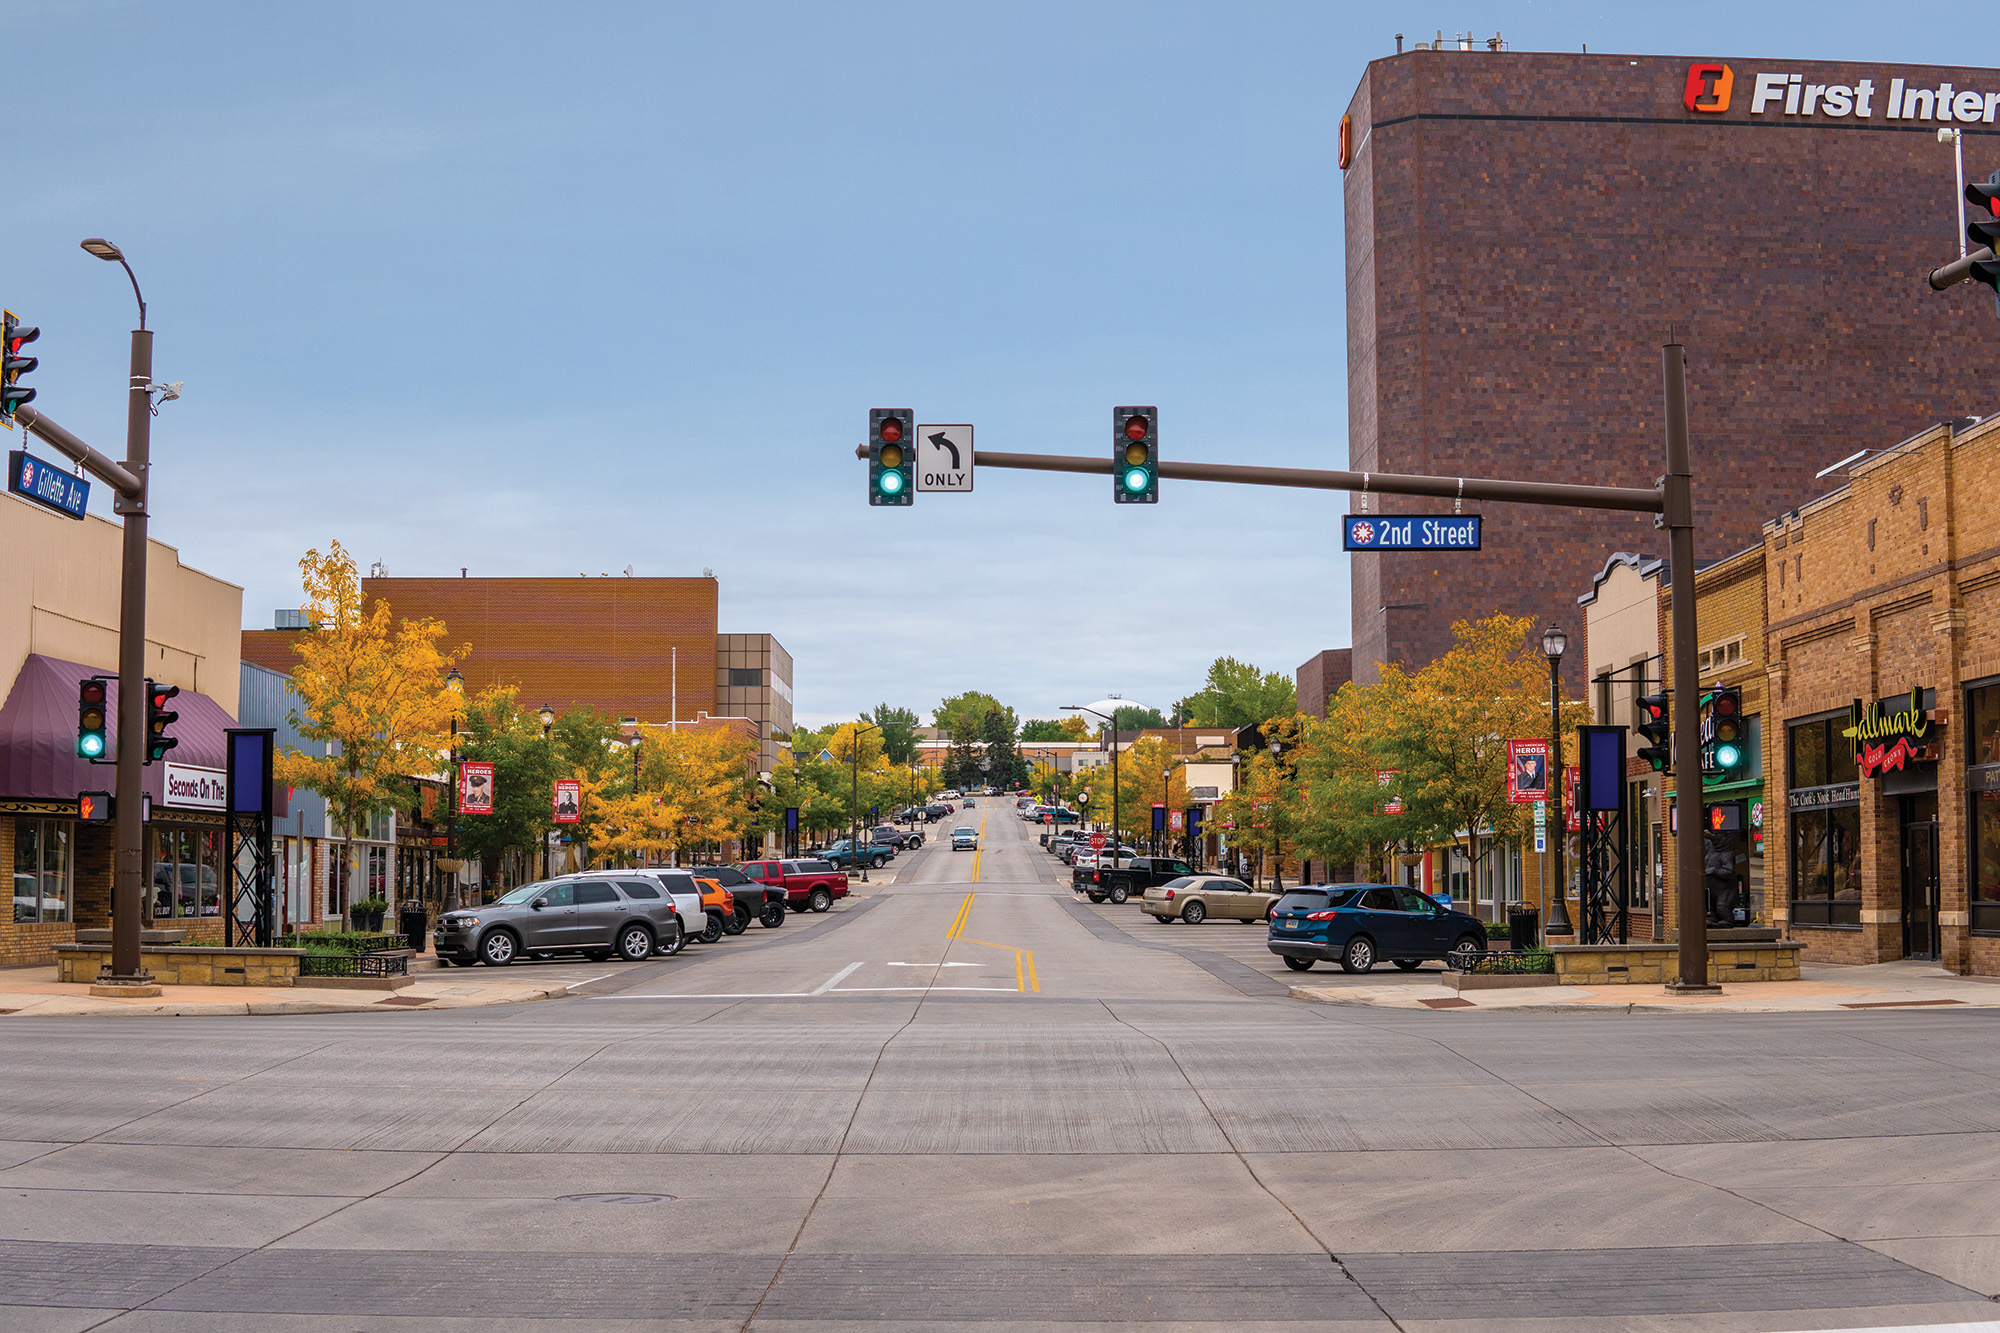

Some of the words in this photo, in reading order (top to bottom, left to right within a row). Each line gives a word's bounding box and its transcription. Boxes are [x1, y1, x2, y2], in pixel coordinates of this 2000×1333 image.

[1750, 72, 1875, 117] First
[1886, 78, 2000, 123] Inter
[37, 467, 65, 504] Gillette
[65, 481, 82, 511] Ave
[924, 473, 966, 486] ONLY
[1379, 520, 1412, 545] 2nd
[1421, 520, 1475, 545] Street
[1842, 686, 1928, 766] Hallmark
[1868, 750, 1883, 764] GOLD
[1883, 749, 1902, 768] CROWN
[168, 773, 199, 798] Seconds
[200, 777, 210, 799] On
[211, 779, 225, 801] The
[1789, 794, 1799, 807] The
[1800, 792, 1816, 806] Cook's
[1817, 790, 1830, 804] Nook
[1090, 837, 1105, 845] STOP
[185, 906, 195, 915] HELP
